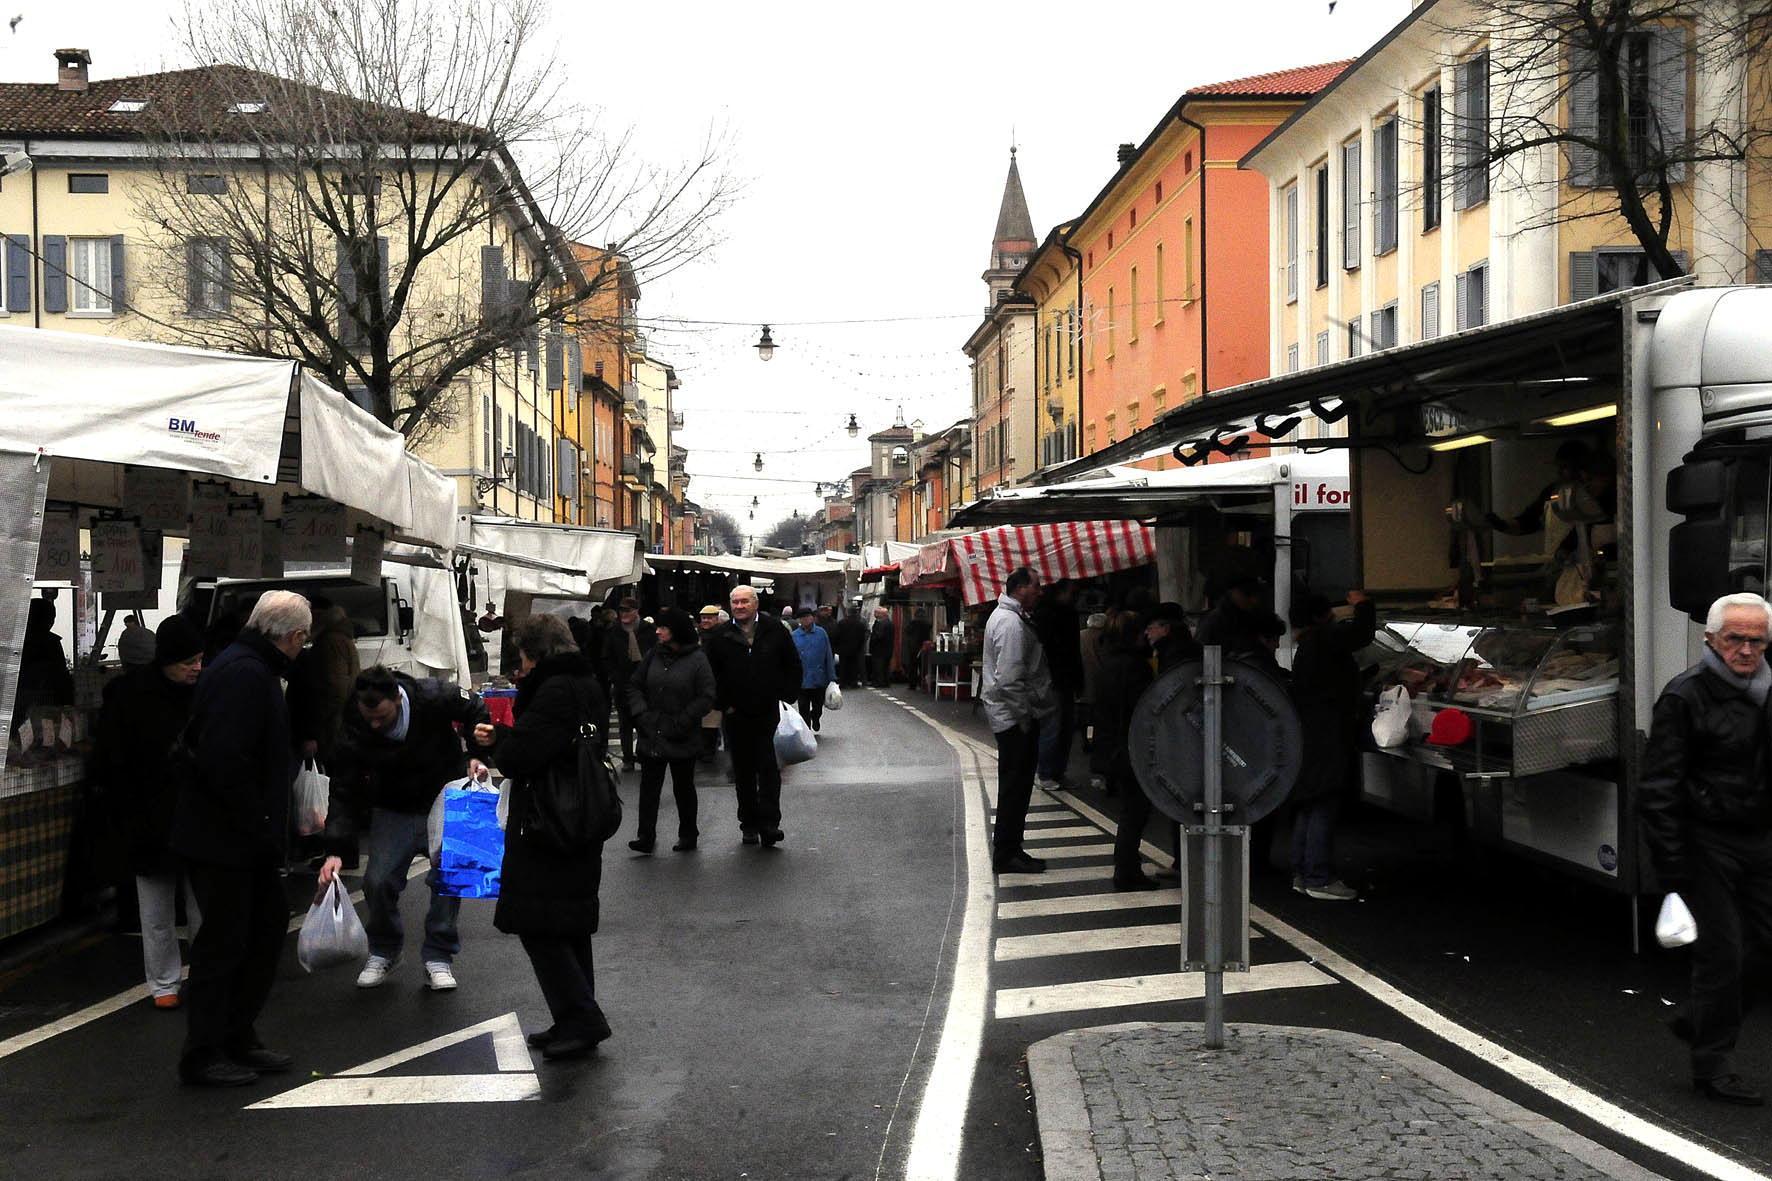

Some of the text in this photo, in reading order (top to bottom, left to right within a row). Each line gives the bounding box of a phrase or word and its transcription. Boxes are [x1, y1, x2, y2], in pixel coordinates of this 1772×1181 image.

[168, 417, 196, 433] BM
[194, 429, 221, 441] Tende
[1294, 483, 1308, 504] il
